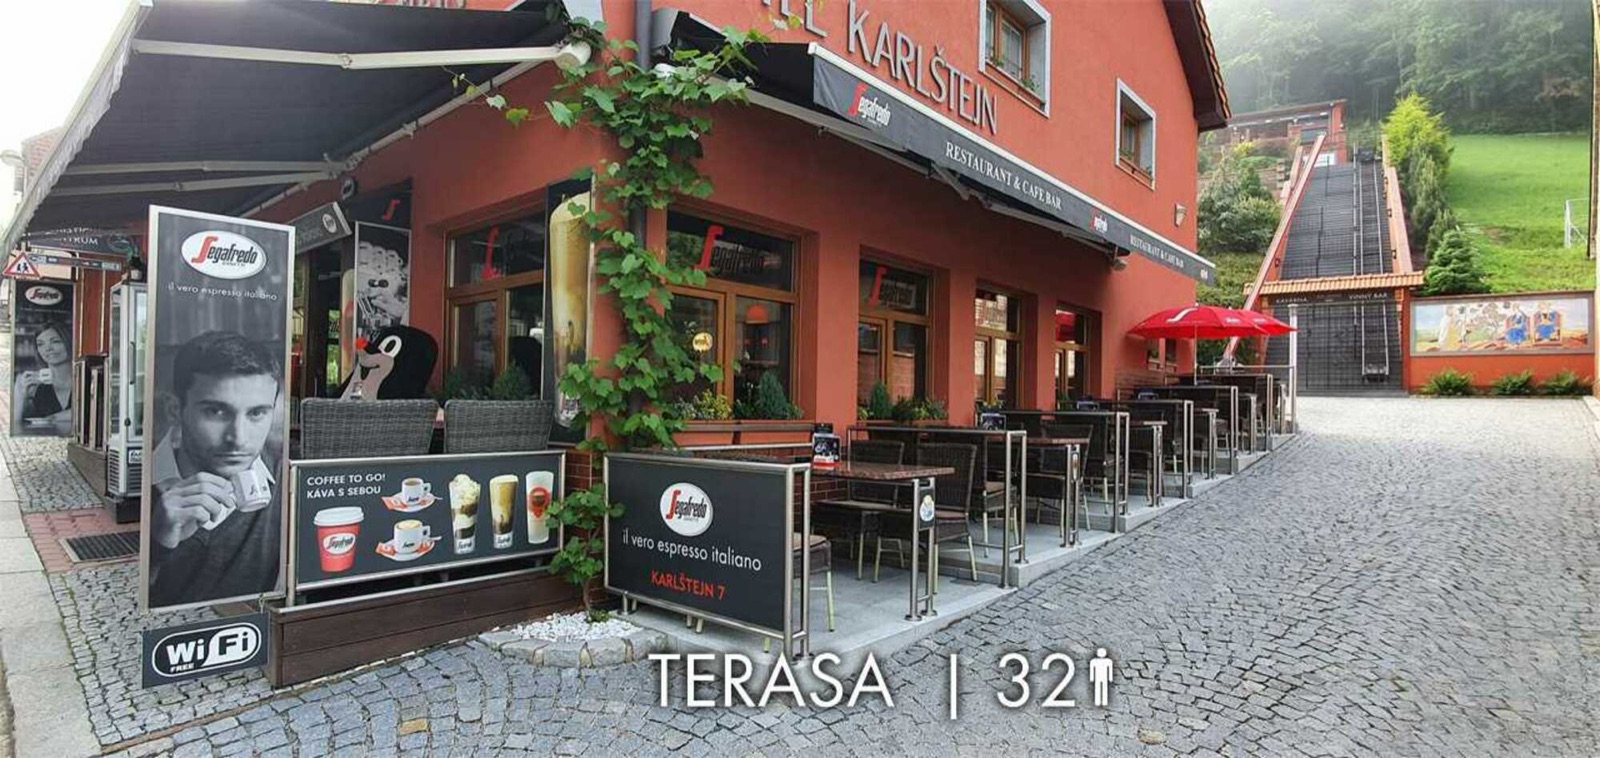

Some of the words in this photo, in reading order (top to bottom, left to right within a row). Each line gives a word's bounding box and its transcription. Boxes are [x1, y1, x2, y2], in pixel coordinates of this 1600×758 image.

[847, 0, 998, 136] KARLŠTEJN
[945, 141, 1012, 186] RESTAURANT
[1013, 176, 1021, 190] &
[1022, 181, 1045, 202] CAFE
[1046, 191, 1062, 210] BAR
[192, 235, 258, 264] Segafredo
[168, 281, 175, 290] il
[177, 284, 199, 293] vero
[201, 287, 242, 297] espresso
[307, 474, 346, 486] COFFEE
[349, 474, 363, 483] TO
[365, 473, 386, 481] GO!
[307, 487, 335, 499] KÁVA
[338, 487, 345, 497] S
[347, 486, 381, 496] SEBOU
[666, 489, 707, 519] Segafredo
[622, 527, 629, 544] il
[631, 534, 654, 550] vero
[657, 540, 708, 560] espresso
[711, 546, 762, 571] italiano
[651, 569, 714, 597] KARLŠTEJN
[714, 586, 726, 600] 7
[166, 631, 249, 665] WiFi
[170, 662, 195, 673] FREE
